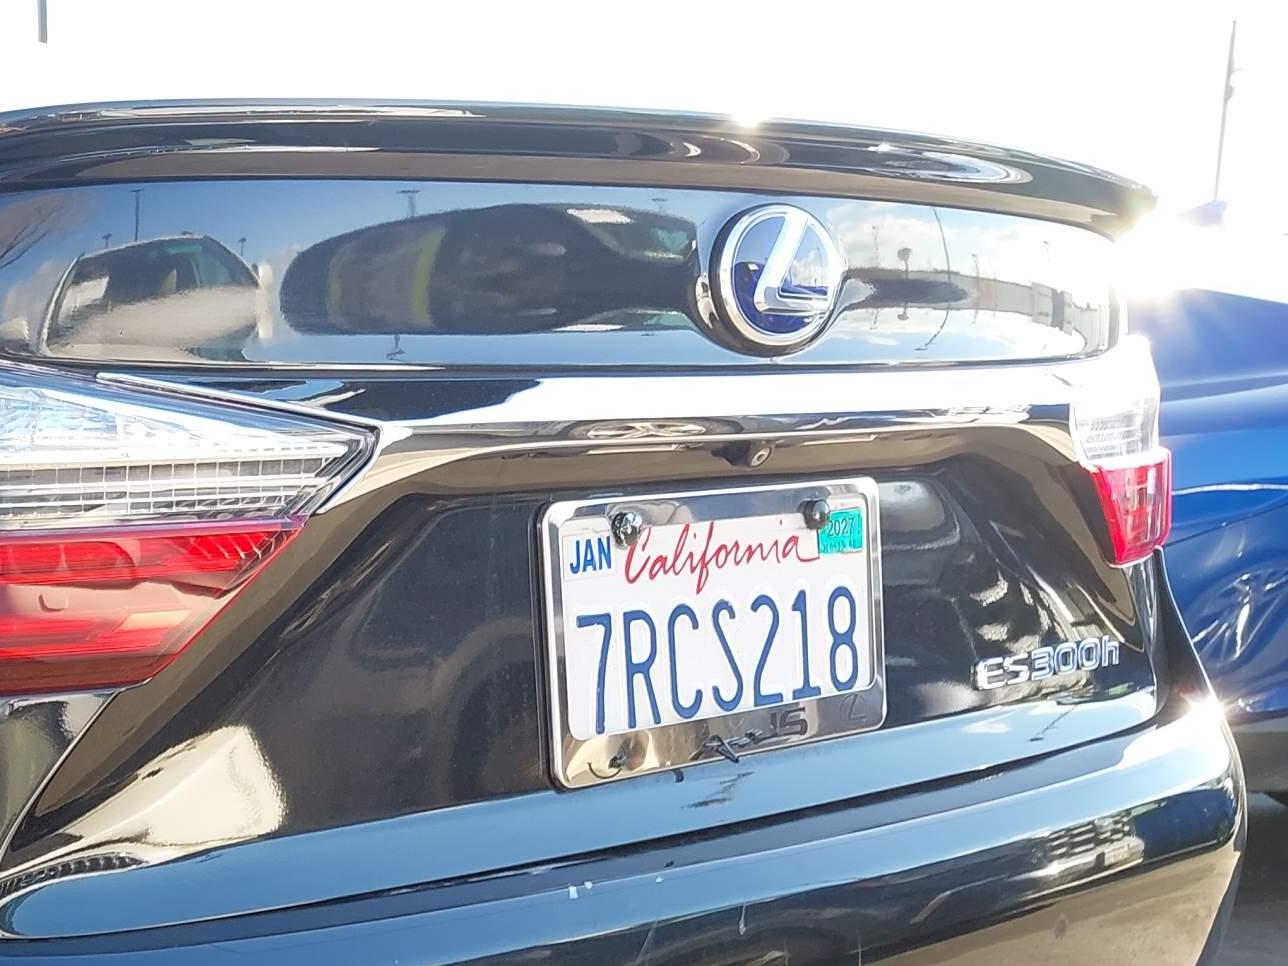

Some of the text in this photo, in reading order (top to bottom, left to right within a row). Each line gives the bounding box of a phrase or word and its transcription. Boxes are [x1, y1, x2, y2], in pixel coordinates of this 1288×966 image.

[569, 535, 612, 575] JAN
[826, 516, 856, 537] 2027
[624, 520, 820, 595] California
[576, 585, 859, 735] 7RCS218
[974, 634, 1120, 691] ES300h
